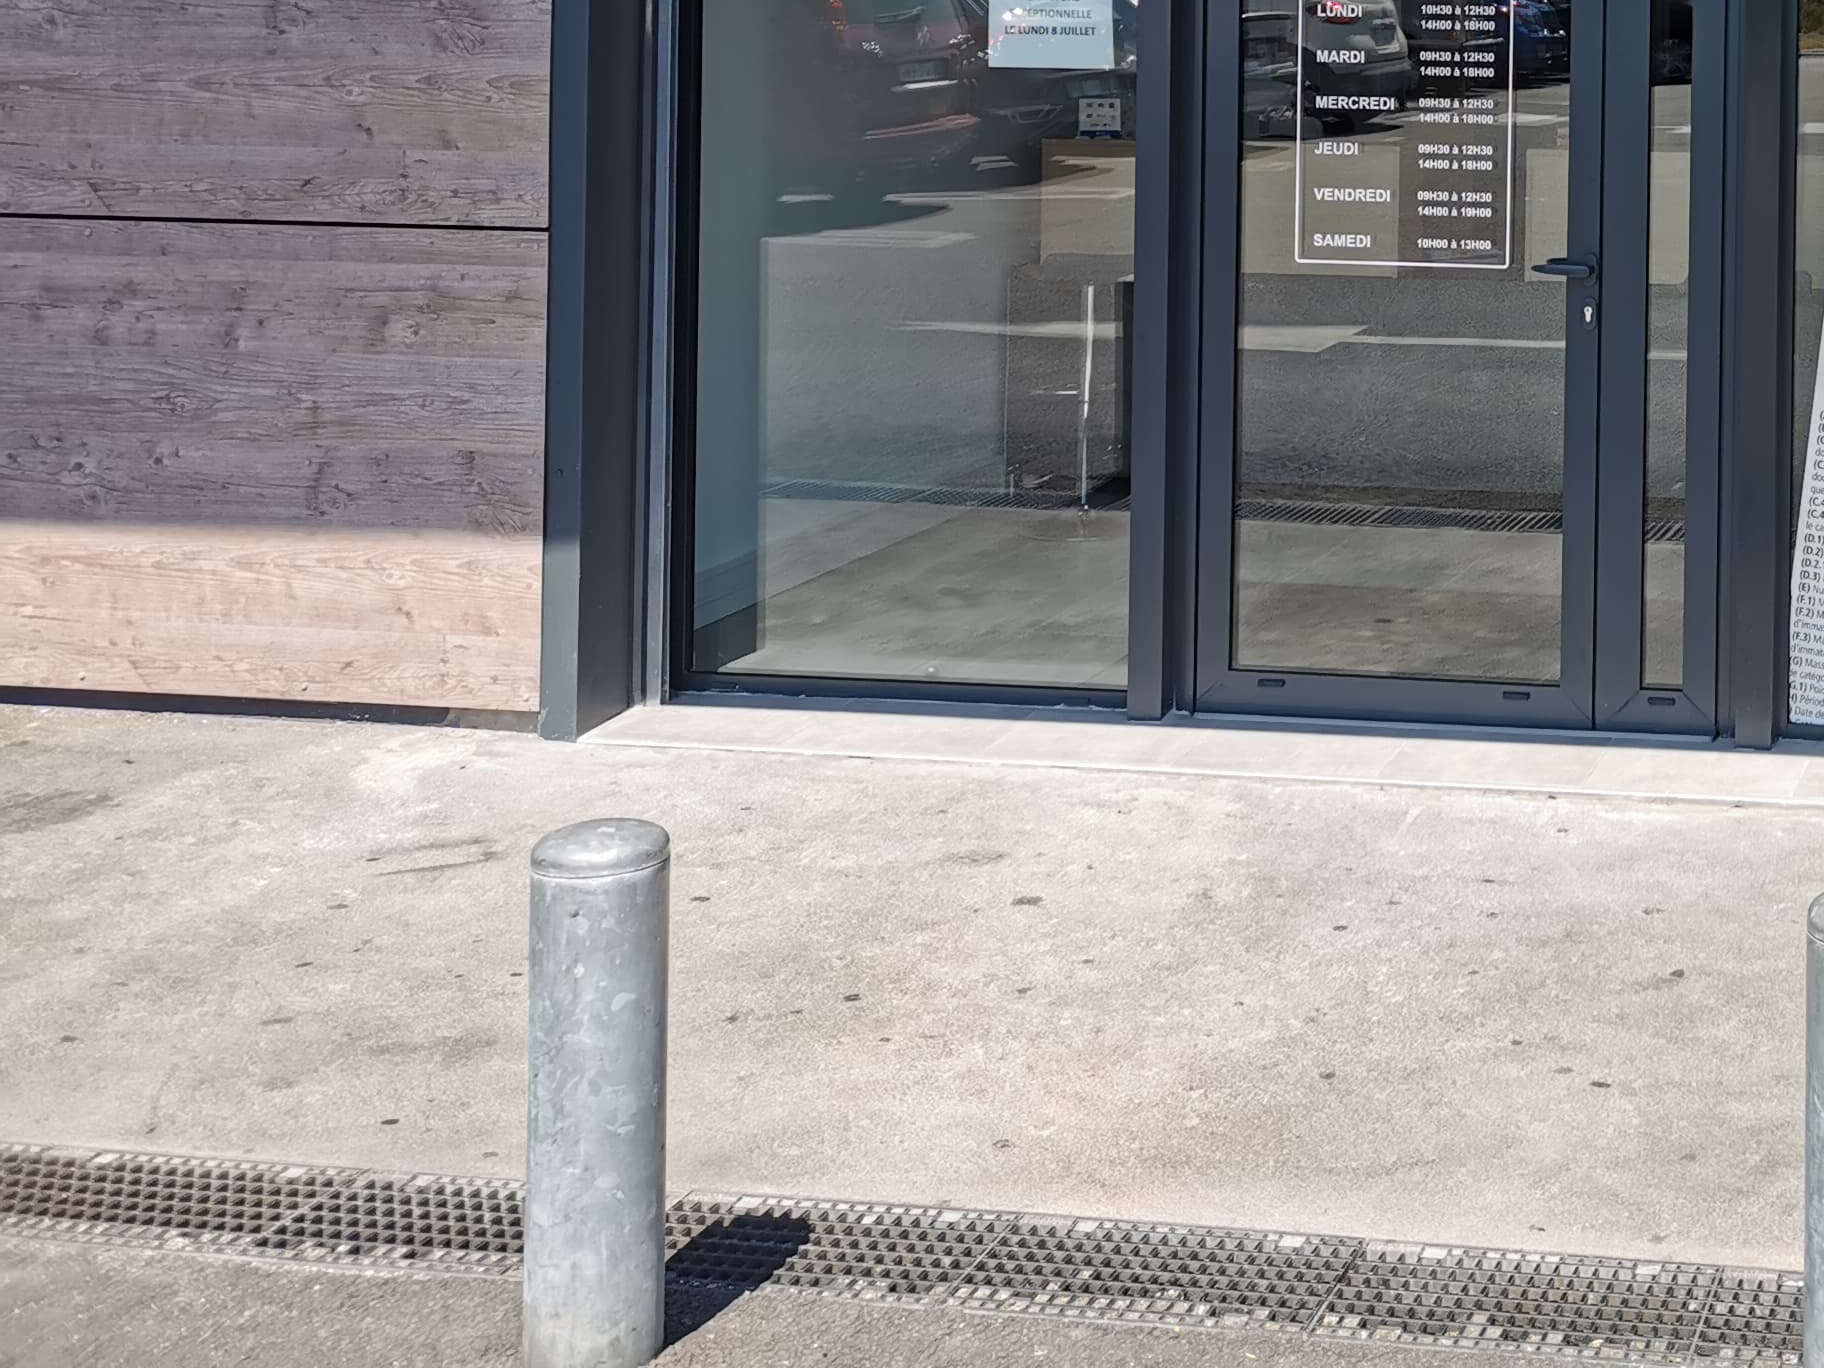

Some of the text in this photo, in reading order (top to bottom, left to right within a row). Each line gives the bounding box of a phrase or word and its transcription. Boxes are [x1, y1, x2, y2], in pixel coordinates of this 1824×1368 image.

[1008, 8, 1092, 19] EPTIONNELLE
[1317, 4, 1495, 18] LUNDI 10H30 à 12H30
[1421, 20, 1452, 30] 14H00
[1454, 20, 1460, 30] à
[1019, 26, 1048, 35] LUNDI
[1051, 27, 1057, 35] 8
[1060, 27, 1096, 36] JUILLET
[1316, 50, 1495, 63] MARDI 09H30 à 12H30
[1420, 66, 1494, 77] 14H00 à 18H00
[1315, 96, 1493, 110] MERCREDI 09H30 à 12H30
[1420, 113, 1450, 123] 14H00
[1314, 142, 1493, 155] JEUDI 09H30 à 12H30
[1418, 159, 1492, 170] 14H00 à 18H00
[1314, 188, 1492, 202] VENDREDI 09H30 à 12H30
[1418, 206, 1448, 216] 14H00
[1451, 207, 1457, 216] à
[1313, 234, 1491, 249] SAMEDI 10H00 à 13H00
